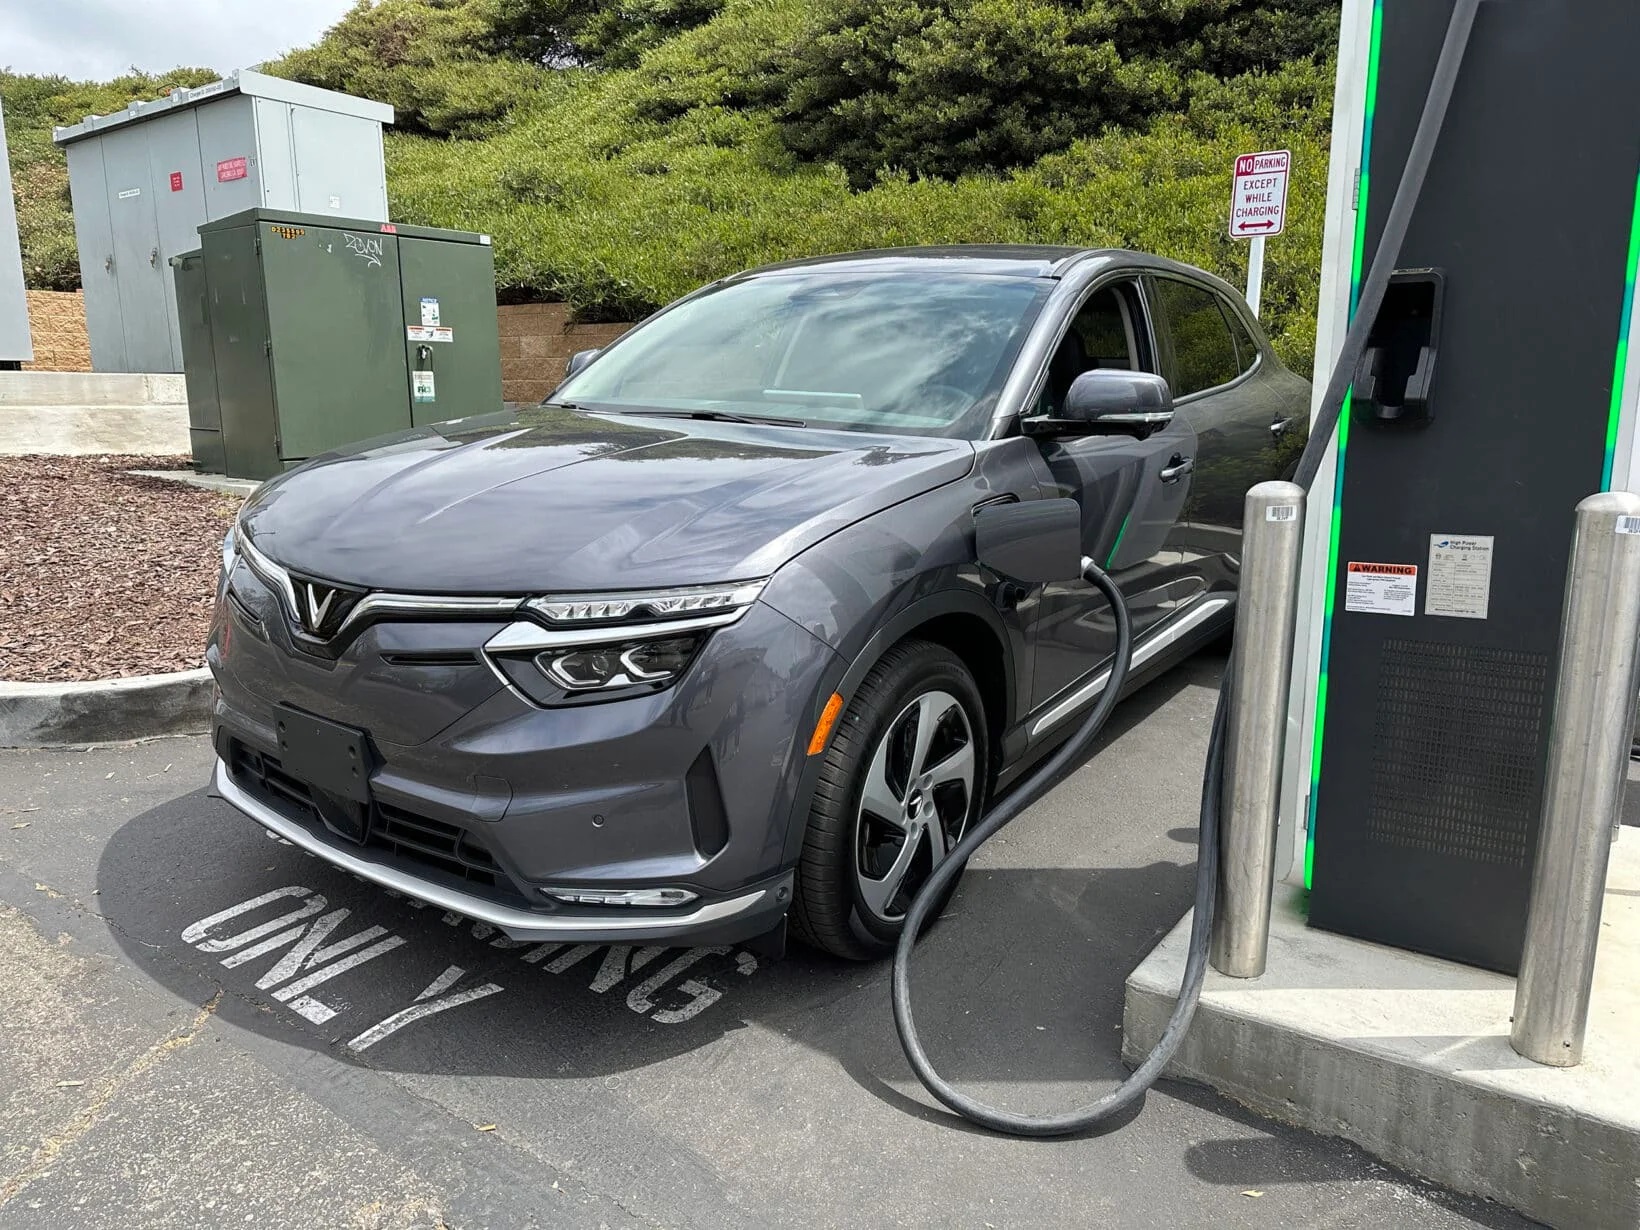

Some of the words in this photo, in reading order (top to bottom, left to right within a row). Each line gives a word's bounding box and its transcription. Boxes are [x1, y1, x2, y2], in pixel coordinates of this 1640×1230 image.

[1239, 159, 1253, 173] NO
[1254, 157, 1286, 170] PARKING
[1243, 178, 1278, 190] EXCEPT
[1245, 192, 1273, 204] WHILE
[1235, 205, 1280, 218] CHARGING
[1361, 563, 1412, 575] WARNING
[180, 885, 505, 1052] ONLY
